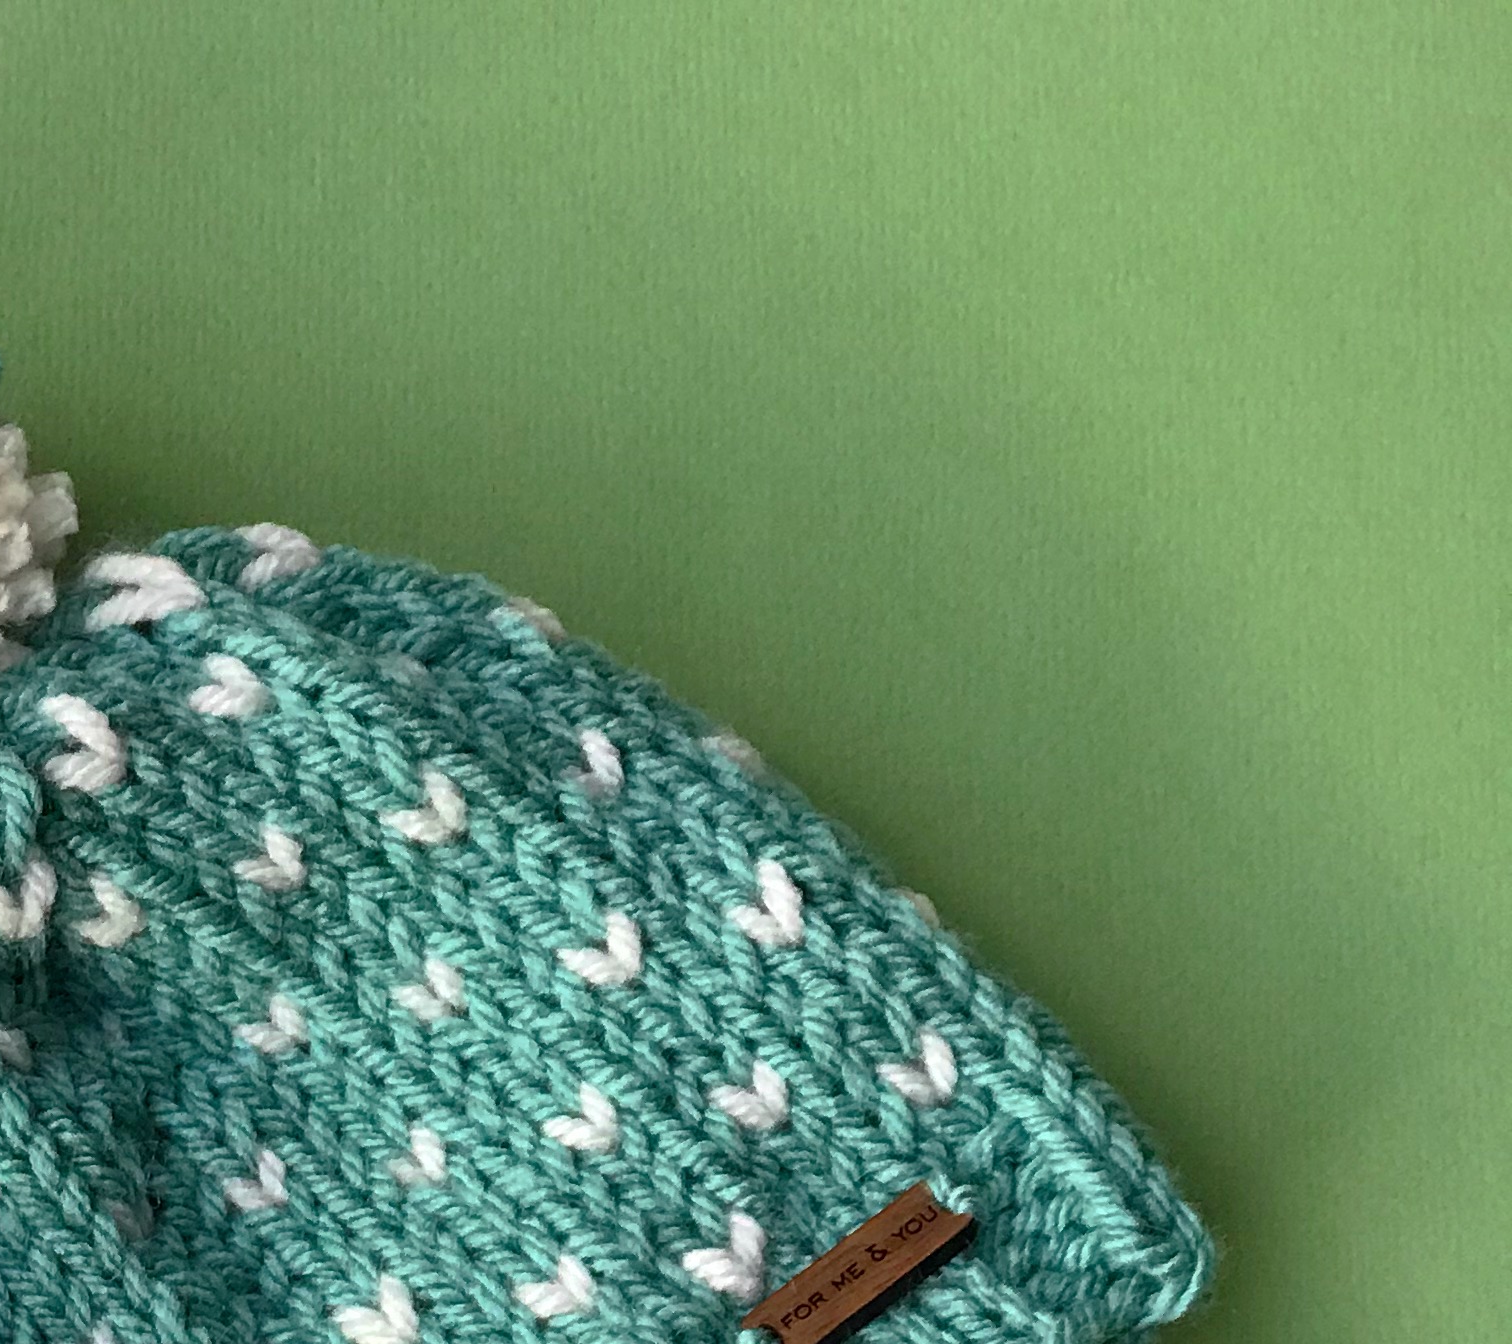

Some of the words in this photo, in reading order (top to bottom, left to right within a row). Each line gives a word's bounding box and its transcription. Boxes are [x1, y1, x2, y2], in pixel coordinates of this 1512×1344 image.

[781, 1291, 829, 1329] FOR
[831, 1262, 865, 1291] ME
[865, 1243, 888, 1262] &
[891, 1205, 938, 1241] YOU
